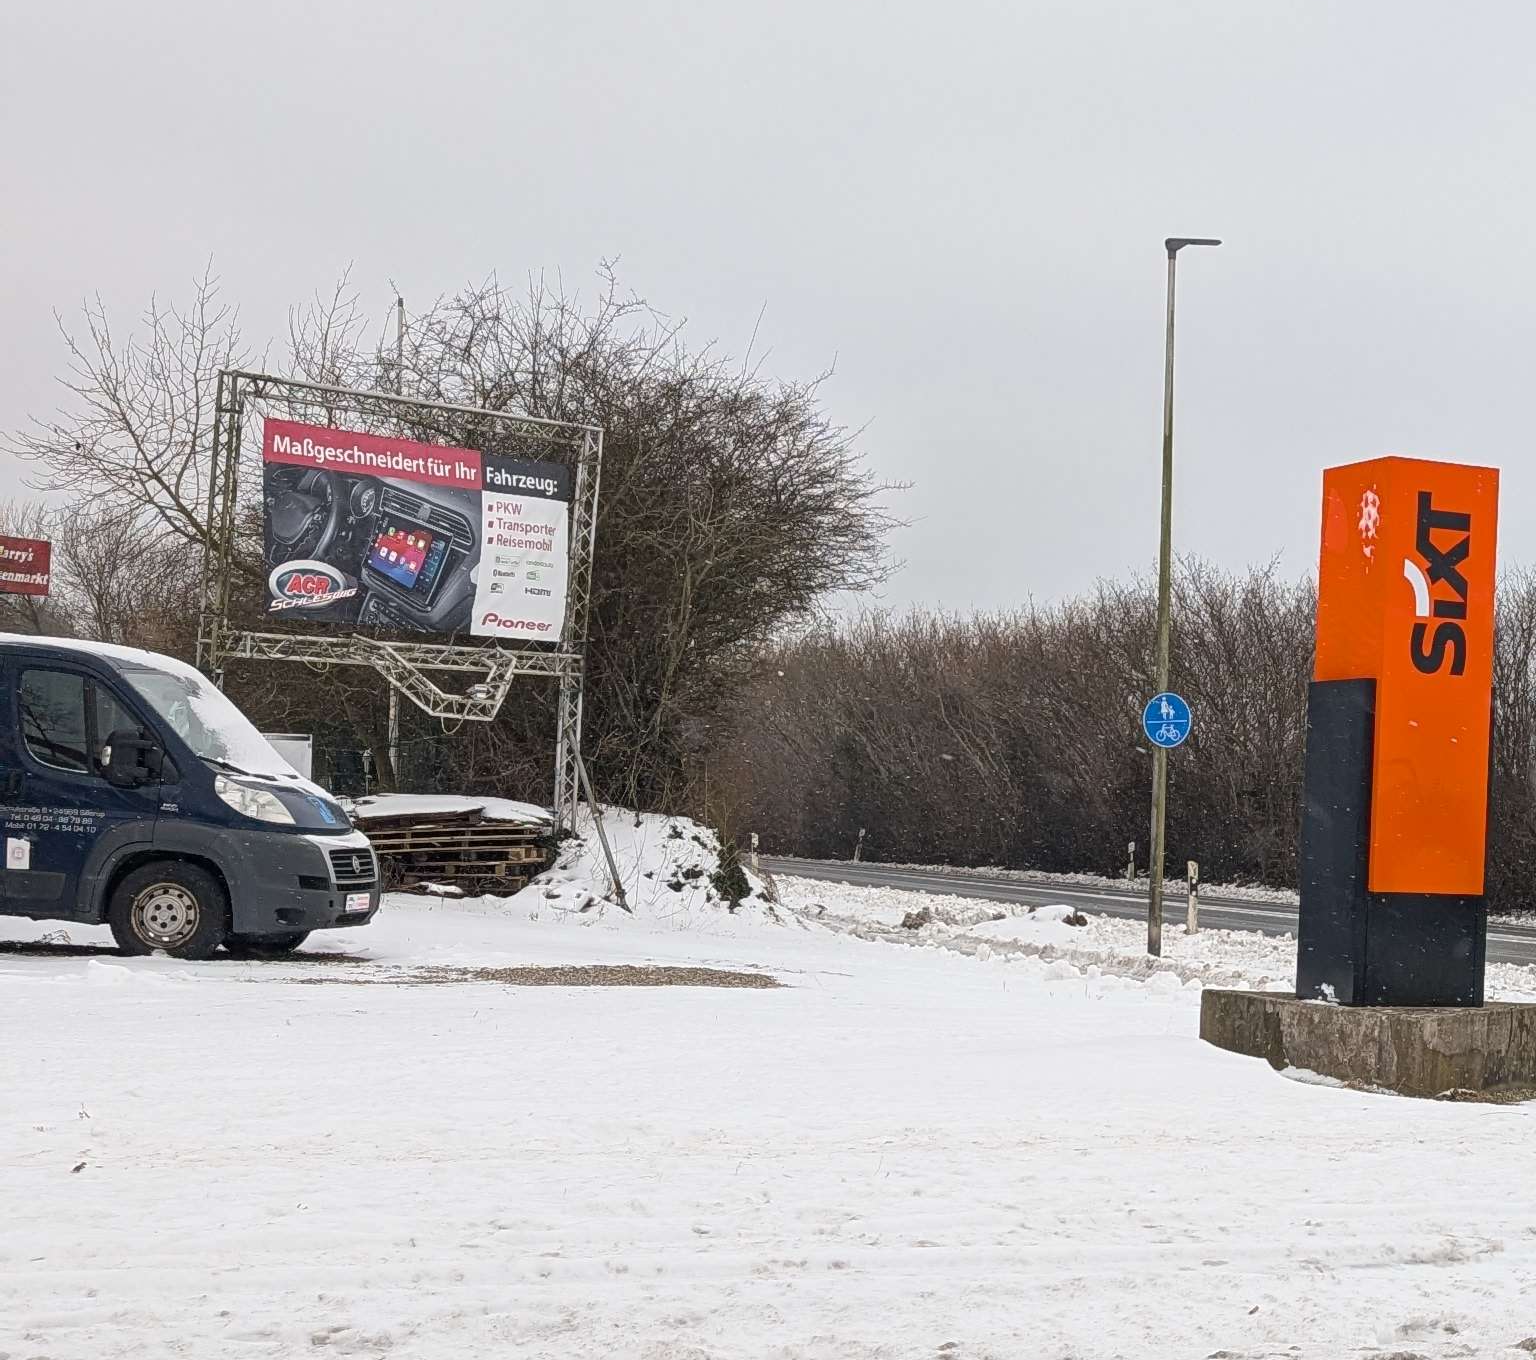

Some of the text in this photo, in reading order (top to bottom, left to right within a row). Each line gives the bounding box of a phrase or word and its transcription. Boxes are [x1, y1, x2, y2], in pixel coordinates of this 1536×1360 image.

[273, 434, 558, 495] Maßgeschneidert für Ihr Fahrzeug:
[496, 501, 522, 515] PKW
[496, 517, 556, 536] Transporter
[496, 533, 552, 551] Reisemobil
[0, 571, 48, 585] enmarkt
[1404, 491, 1471, 676] SIXT
[481, 612, 552, 631] Pioneer
